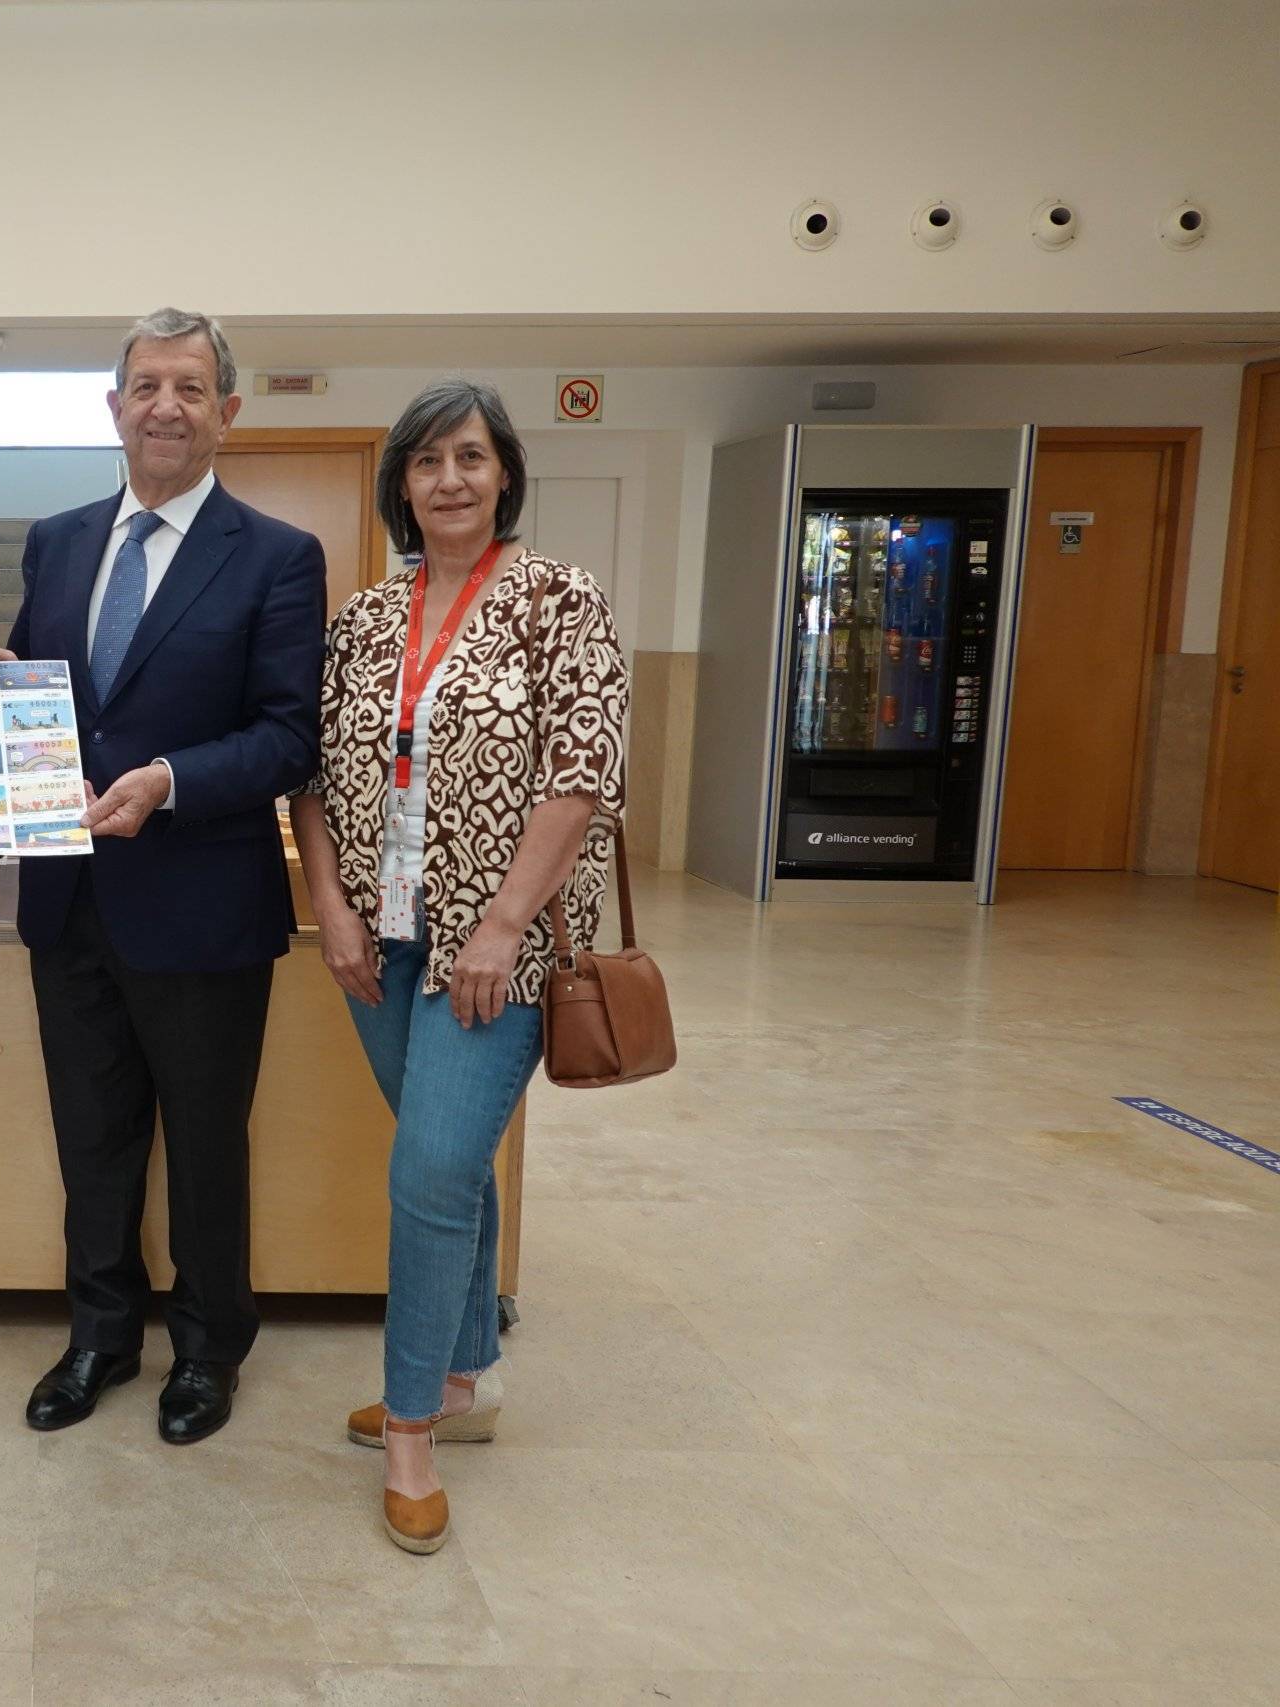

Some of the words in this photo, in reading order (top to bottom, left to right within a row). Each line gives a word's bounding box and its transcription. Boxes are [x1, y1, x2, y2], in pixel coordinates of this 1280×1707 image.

[826, 833, 870, 843] alliance
[873, 835, 914, 847] vending
[1157, 1113, 1233, 1141] ESPERE
